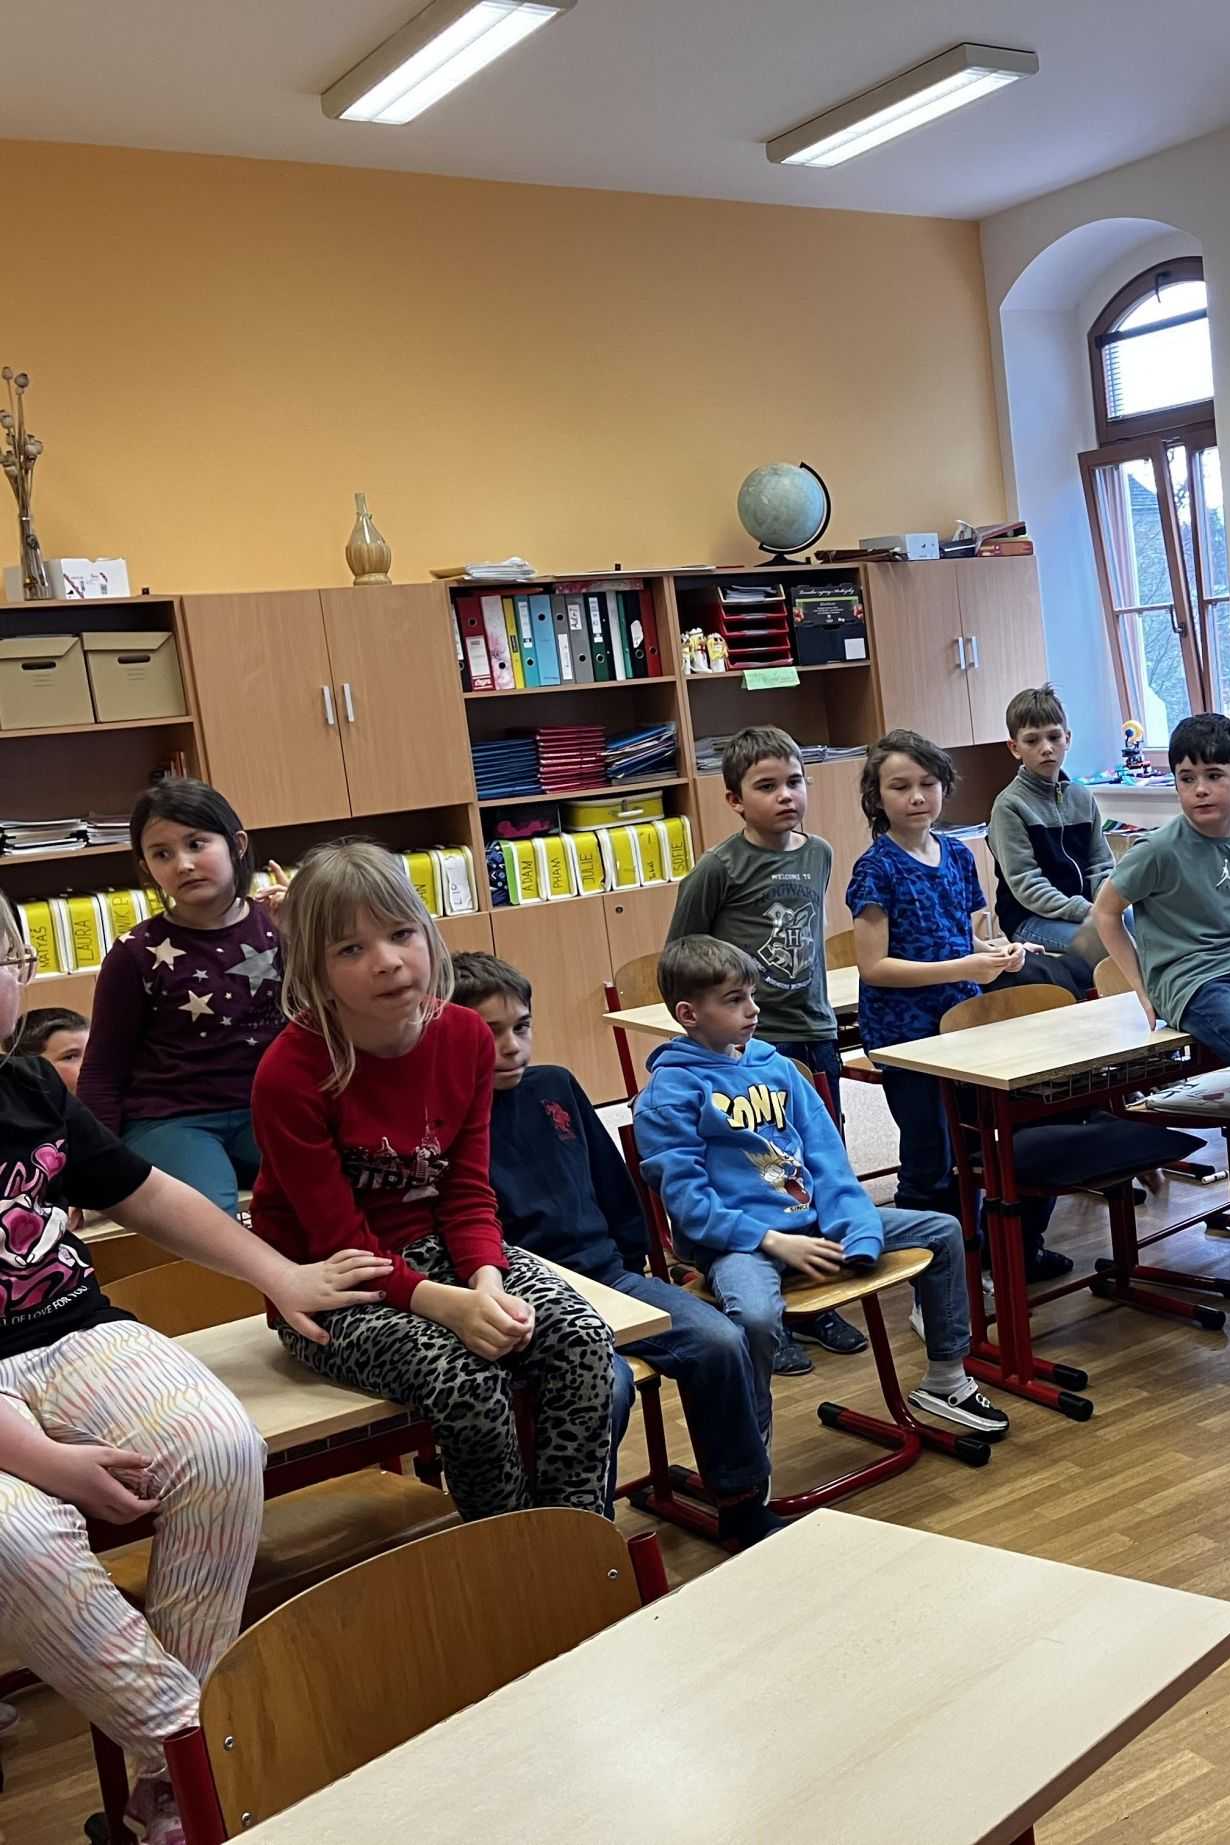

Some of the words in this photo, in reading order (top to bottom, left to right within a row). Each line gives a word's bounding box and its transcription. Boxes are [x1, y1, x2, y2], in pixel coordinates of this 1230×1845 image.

[521, 860, 534, 892] ADAM
[73, 919, 95, 961] LAURA
[787, 929, 801, 946] H
[28, 1304, 53, 1321] LOVE
[52, 1296, 72, 1310] FOR
[68, 1285, 88, 1298] YOU
